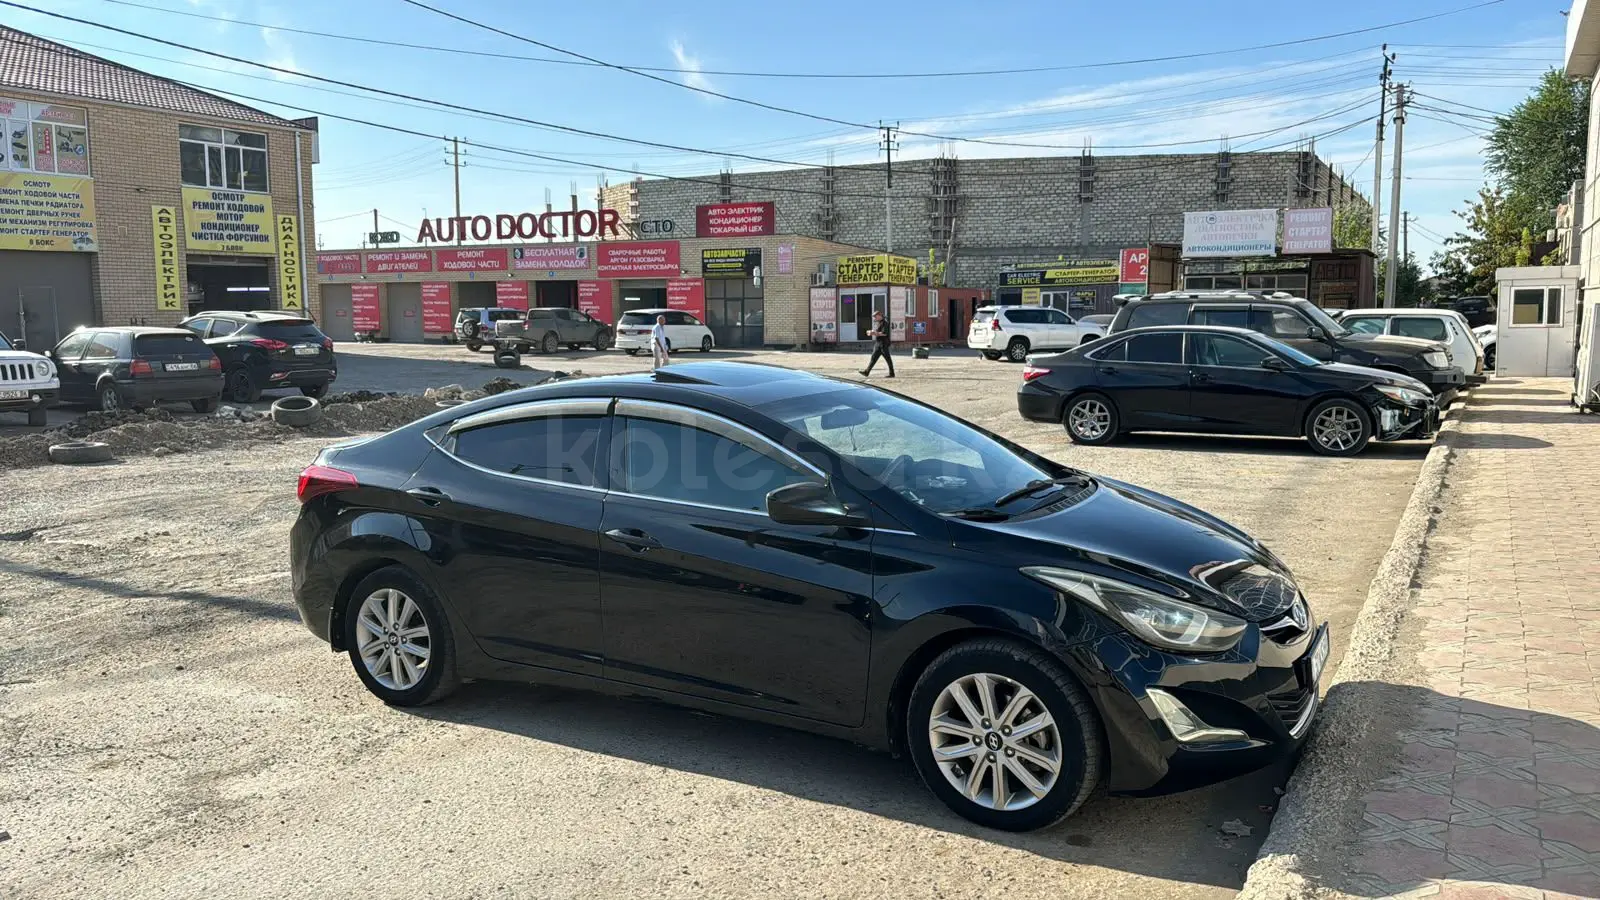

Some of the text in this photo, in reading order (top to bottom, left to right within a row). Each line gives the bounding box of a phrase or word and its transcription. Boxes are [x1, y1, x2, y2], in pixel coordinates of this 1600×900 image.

[23, 180, 51, 188] ОСМОТР
[24, 189, 57, 198] ХОДОВОЙ
[212, 192, 245, 202] ОСМОТР
[46, 201, 84, 209] РАДИАТОРА
[192, 201, 265, 213] РЕМОНТ ХОДОВОЙ
[26, 209, 59, 217] ДВЕРНЫХ
[708, 206, 764, 216] АВТО ЭЛЕКТРИК
[216, 212, 244, 221] МОТОР
[709, 216, 763, 225] КОНДИЦИОНЕР
[9, 218, 47, 226] МЕХАНИЗМ
[48, 220, 94, 228] РЕГУЛИРОВКА
[200, 222, 260, 233] КОНДИЦИОНЕР
[417, 215, 492, 243] AUTO
[495, 209, 620, 240] DOCTOR
[640, 219, 674, 233] СТО
[21, 228, 50, 236] СТАРТЕР
[52, 230, 89, 238] ГЕНЕРАТОР
[709, 225, 763, 234] ТОКАРНЫЙ ЦЕХ
[1288, 226, 1328, 238] СТАРТЕР
[191, 232, 270, 243] ЧИСТКА ФОРСУНОК
[1186, 243, 1272, 253] АВТОКОНДИЦИОНЕРЫ
[1285, 239, 1330, 250] ГЕНЕРАТОР
[367, 253, 394, 261] РЕМОНТ
[402, 252, 428, 260] ЗАМЕНА
[457, 250, 485, 259] РЕМОНТ
[524, 248, 575, 257] БЕСПЛАТНАЯ
[703, 249, 746, 258] АВТОЗАПЧАСТИ
[157, 208, 177, 308] АВТОЭЛЕКТРИК
[281, 217, 298, 308] ДИАГНОСТИКА
[846, 256, 875, 264] РЕМОНТ
[377, 263, 419, 271] ДВИГАТЕЛЕЙ
[443, 260, 500, 269] ХОДОВОЙ ЧАСТИ
[515, 259, 586, 268] ЗАМЕНА КОЛОДОК
[633, 263, 679, 271] ЭЛЕКТРОСВАРКА
[838, 263, 884, 275] СТАРТЕР
[888, 263, 915, 275] СТАРТЕР
[1055, 269, 1116, 277] СТАРТЕР-ГЕНЕРАТОР
[838, 272, 884, 282] ГЕНЕРАТОР
[888, 273, 915, 283] ГЕНЕРАТОР
[1007, 277, 1040, 285] SERVICE
